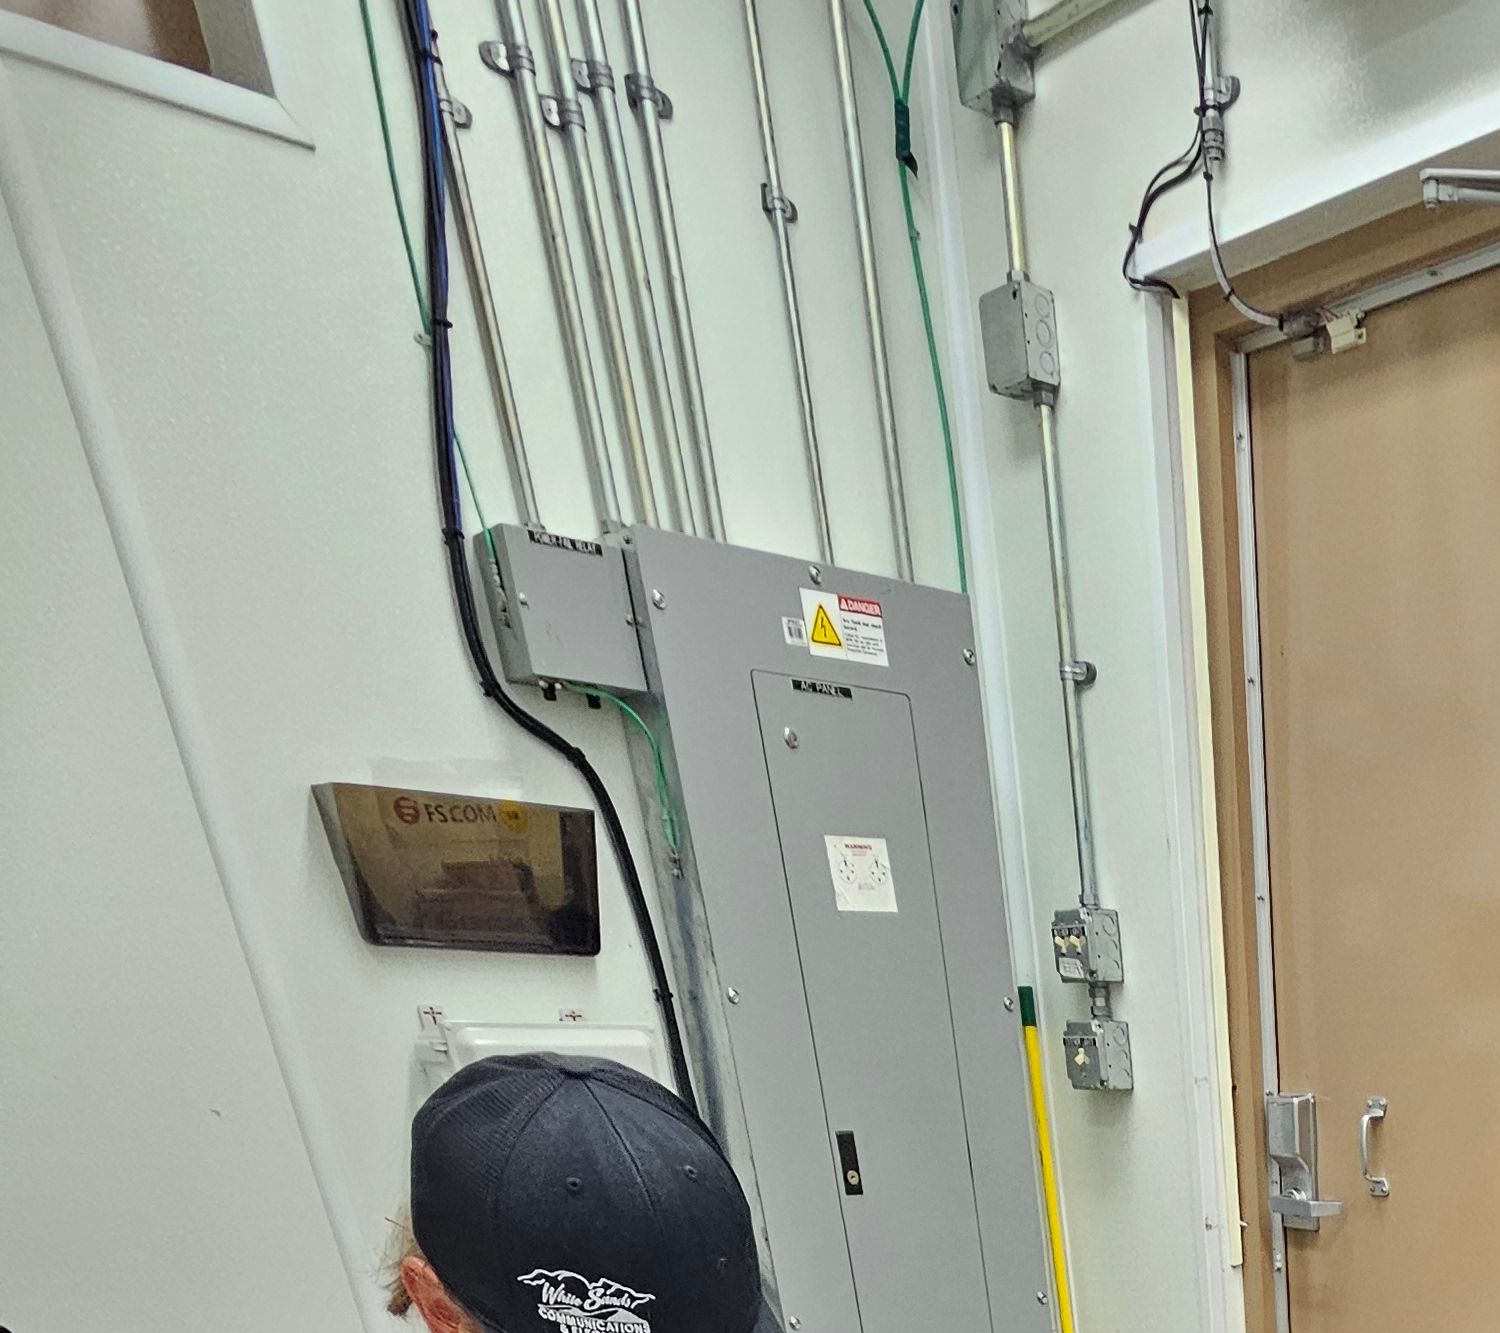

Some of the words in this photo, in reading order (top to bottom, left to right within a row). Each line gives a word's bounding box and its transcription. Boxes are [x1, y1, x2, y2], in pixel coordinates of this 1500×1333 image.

[847, 599, 881, 616] DANGER
[801, 680, 813, 692] AC
[816, 682, 843, 698] PANEL
[541, 1281, 583, 1306] White
[583, 1287, 632, 1310] Sands
[537, 1306, 651, 1333] COMMUNICATIONS
